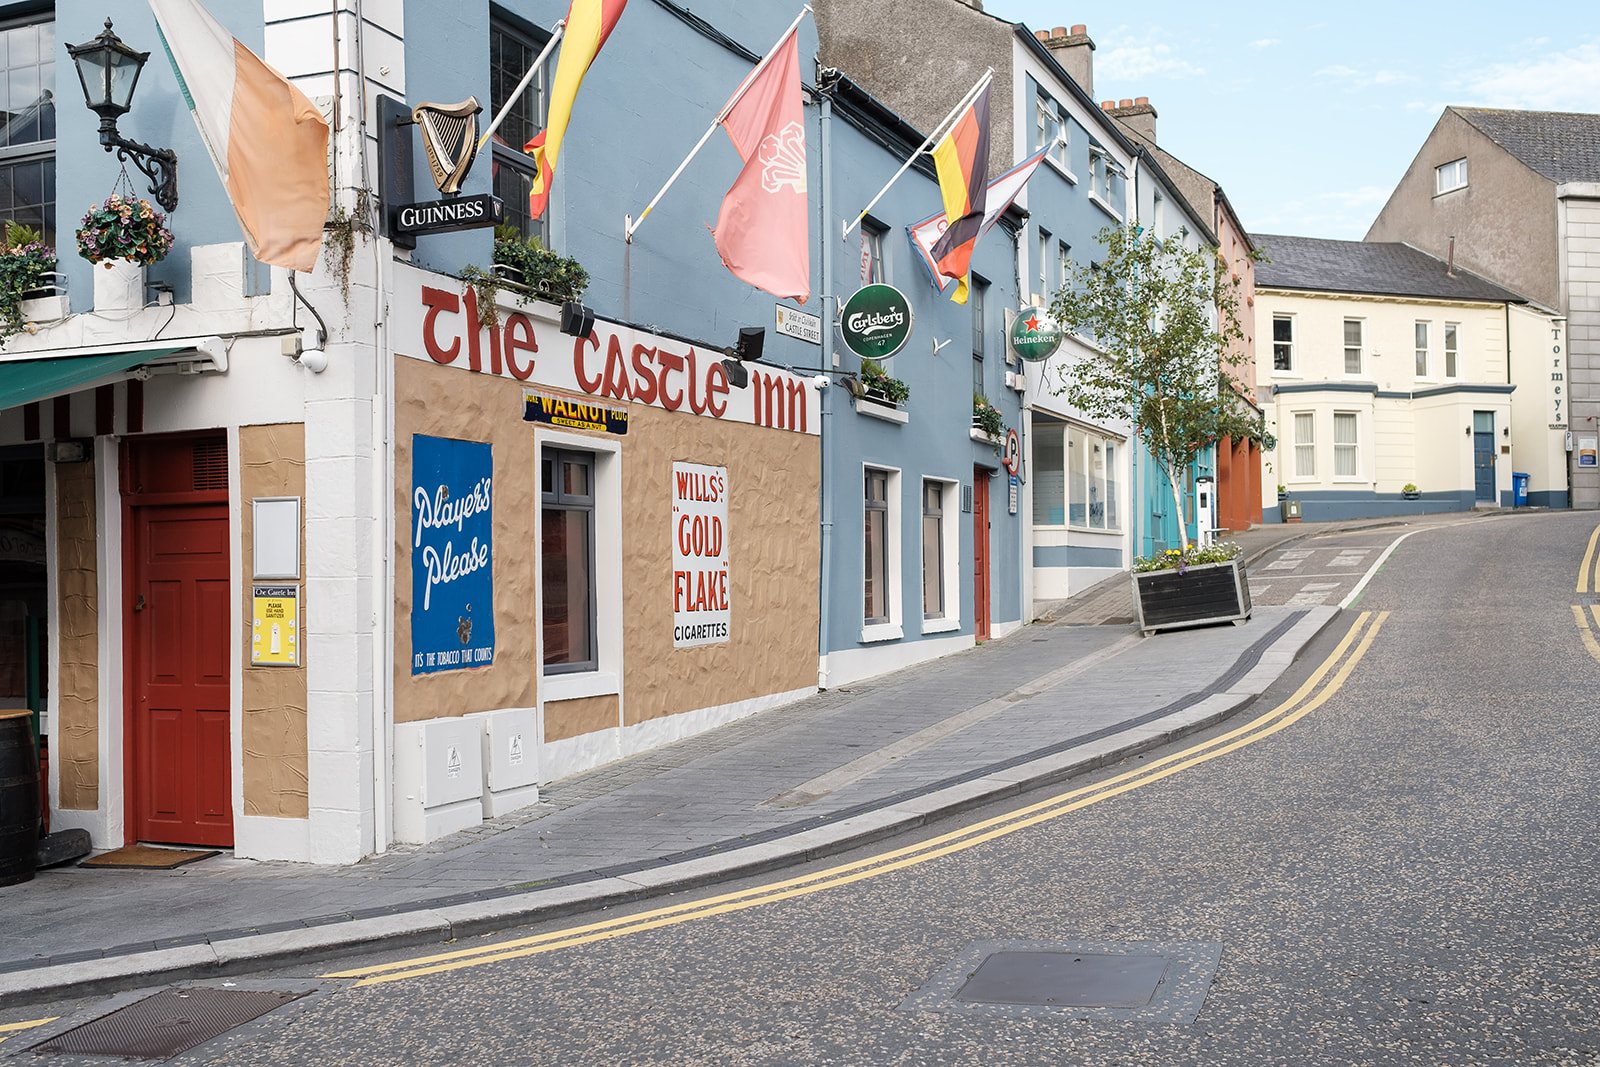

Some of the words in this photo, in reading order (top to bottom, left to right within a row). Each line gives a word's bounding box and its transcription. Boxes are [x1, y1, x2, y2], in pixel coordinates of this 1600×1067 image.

[431, 160, 444, 178] 1759
[401, 200, 484, 227] GUINNESS
[785, 322, 803, 337] CASTLE
[804, 328, 820, 341] STREET
[848, 308, 904, 334] Carlsberg
[1013, 335, 1055, 345] Heineken
[1551, 328, 1563, 422] Tormeys
[541, 397, 606, 423] WALNUT
[611, 409, 628, 422] PLUG
[556, 418, 576, 427] SWEET
[577, 420, 585, 428] AS
[591, 423, 602, 431] NUT
[415, 477, 492, 548] Player's
[423, 536, 489, 611] Please
[415, 651, 424, 668] IT'S
[426, 652, 435, 667] THE
[437, 650, 460, 667] TOBACCO
[461, 648, 473, 664] THAT
[474, 647, 492, 662] COUNTS
